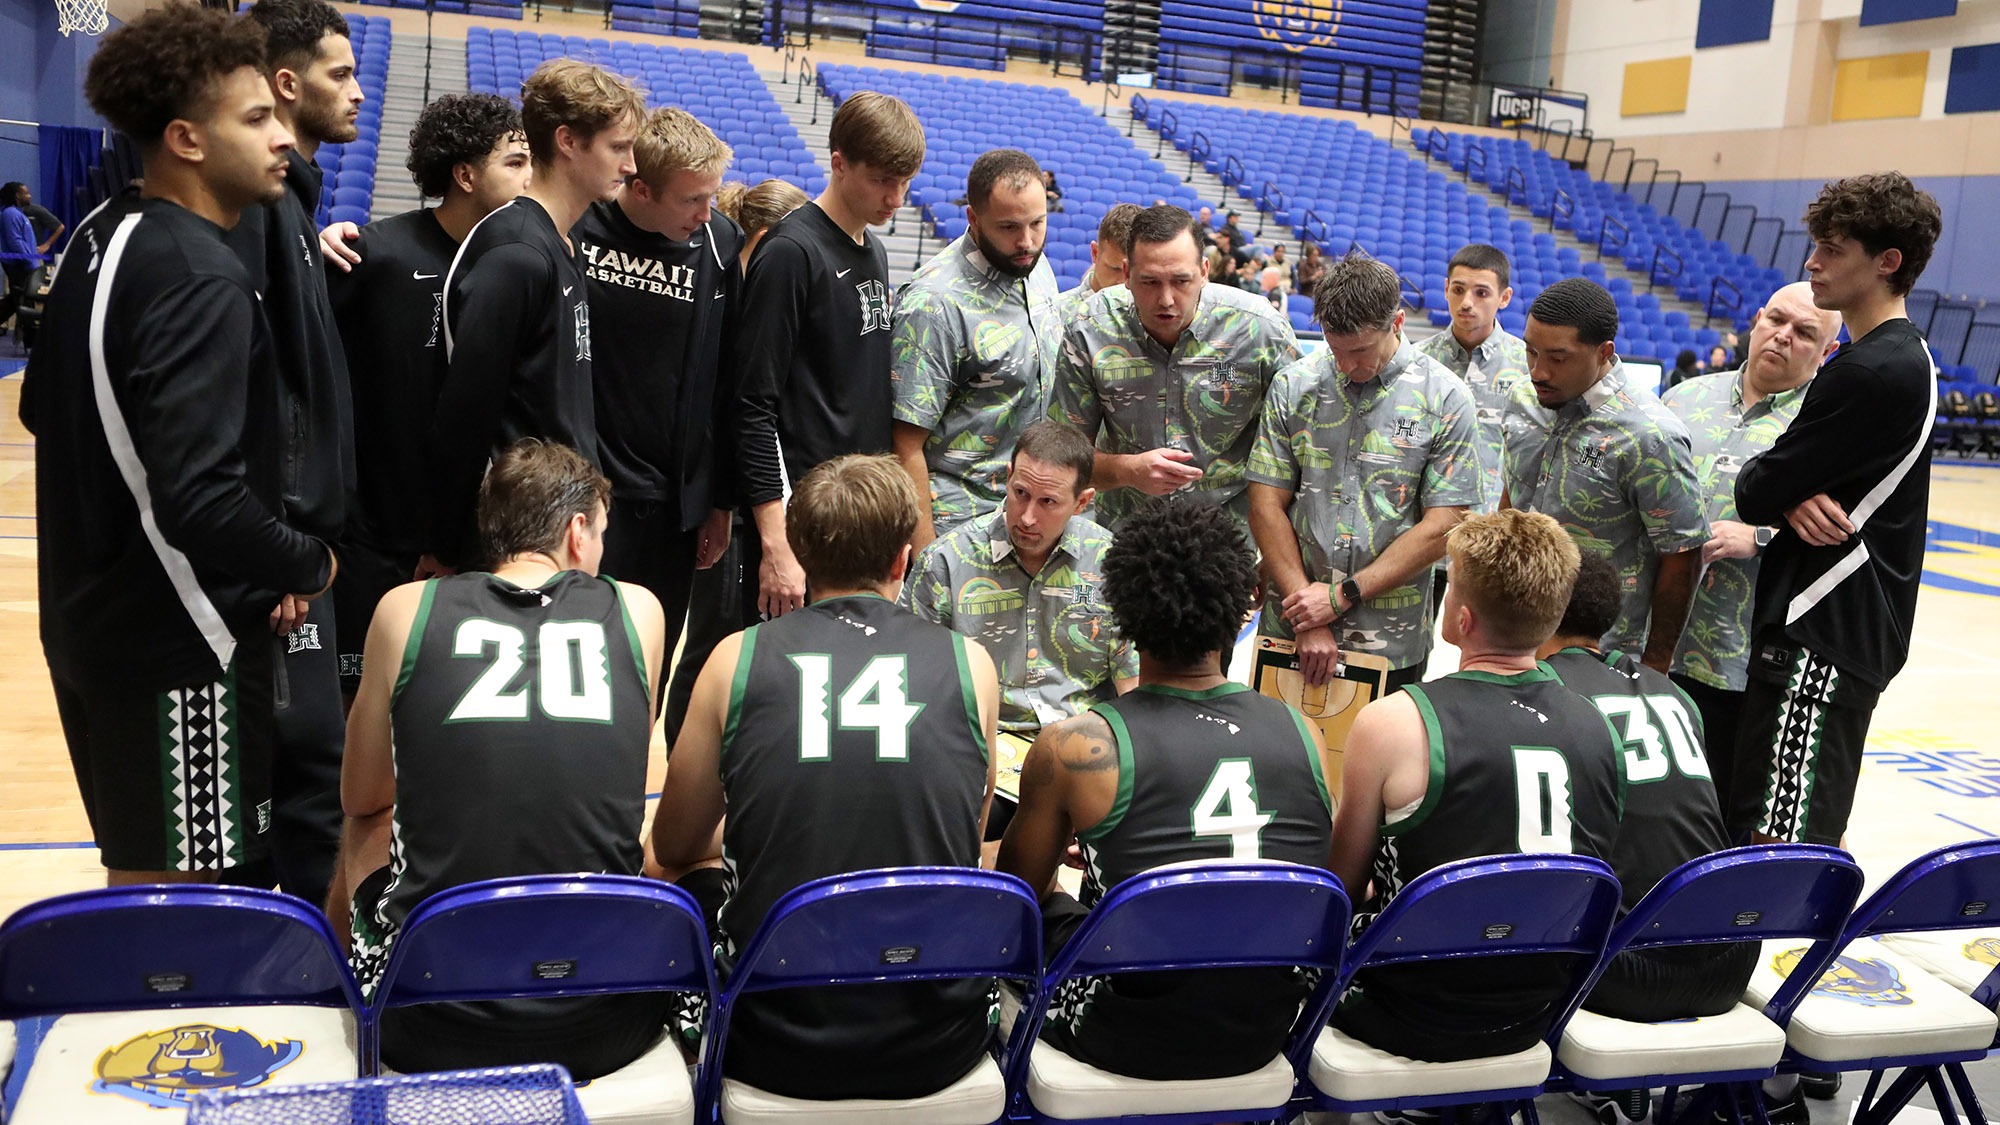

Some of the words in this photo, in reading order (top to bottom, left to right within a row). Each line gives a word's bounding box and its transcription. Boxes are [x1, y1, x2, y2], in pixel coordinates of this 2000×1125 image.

[1499, 96, 1532, 118] UCR
[585, 266, 695, 303] ASKETBALL
[855, 280, 891, 337] H
[443, 617, 615, 725] 20
[786, 652, 927, 763] 14
[1592, 693, 1712, 785] 30
[1190, 756, 1277, 859] 4
[1511, 745, 1575, 855] 0
